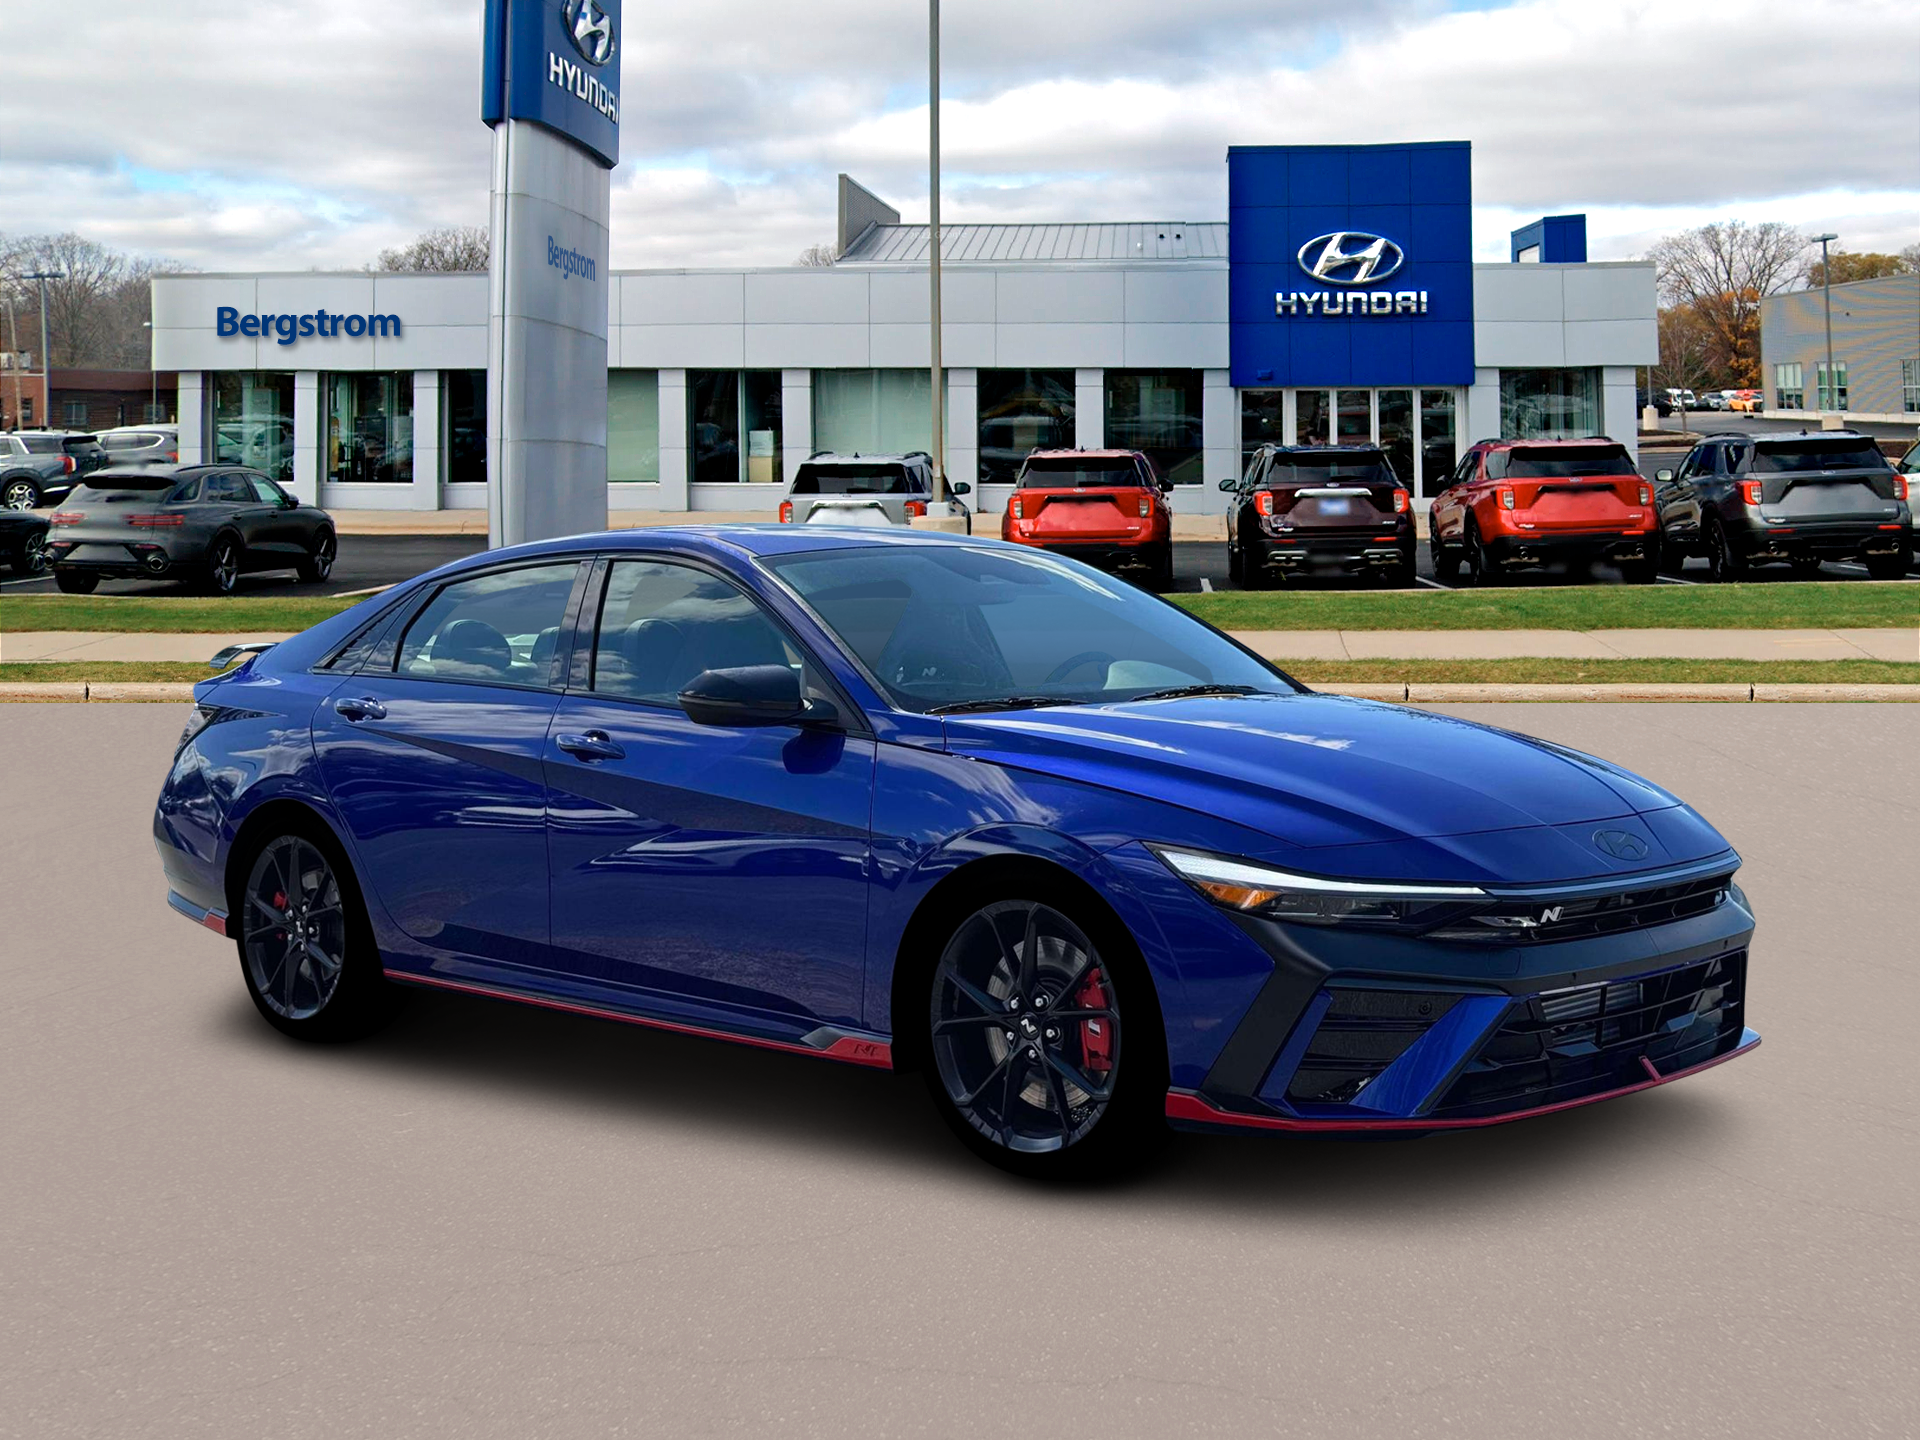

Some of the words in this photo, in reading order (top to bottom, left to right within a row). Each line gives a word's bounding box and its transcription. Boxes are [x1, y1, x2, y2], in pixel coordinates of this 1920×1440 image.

[549, 52, 619, 124] HYUNDAI
[548, 235, 596, 282] Bergstrom
[1275, 291, 1428, 315] HYUNDAI
[216, 306, 402, 346] Bergstrom
